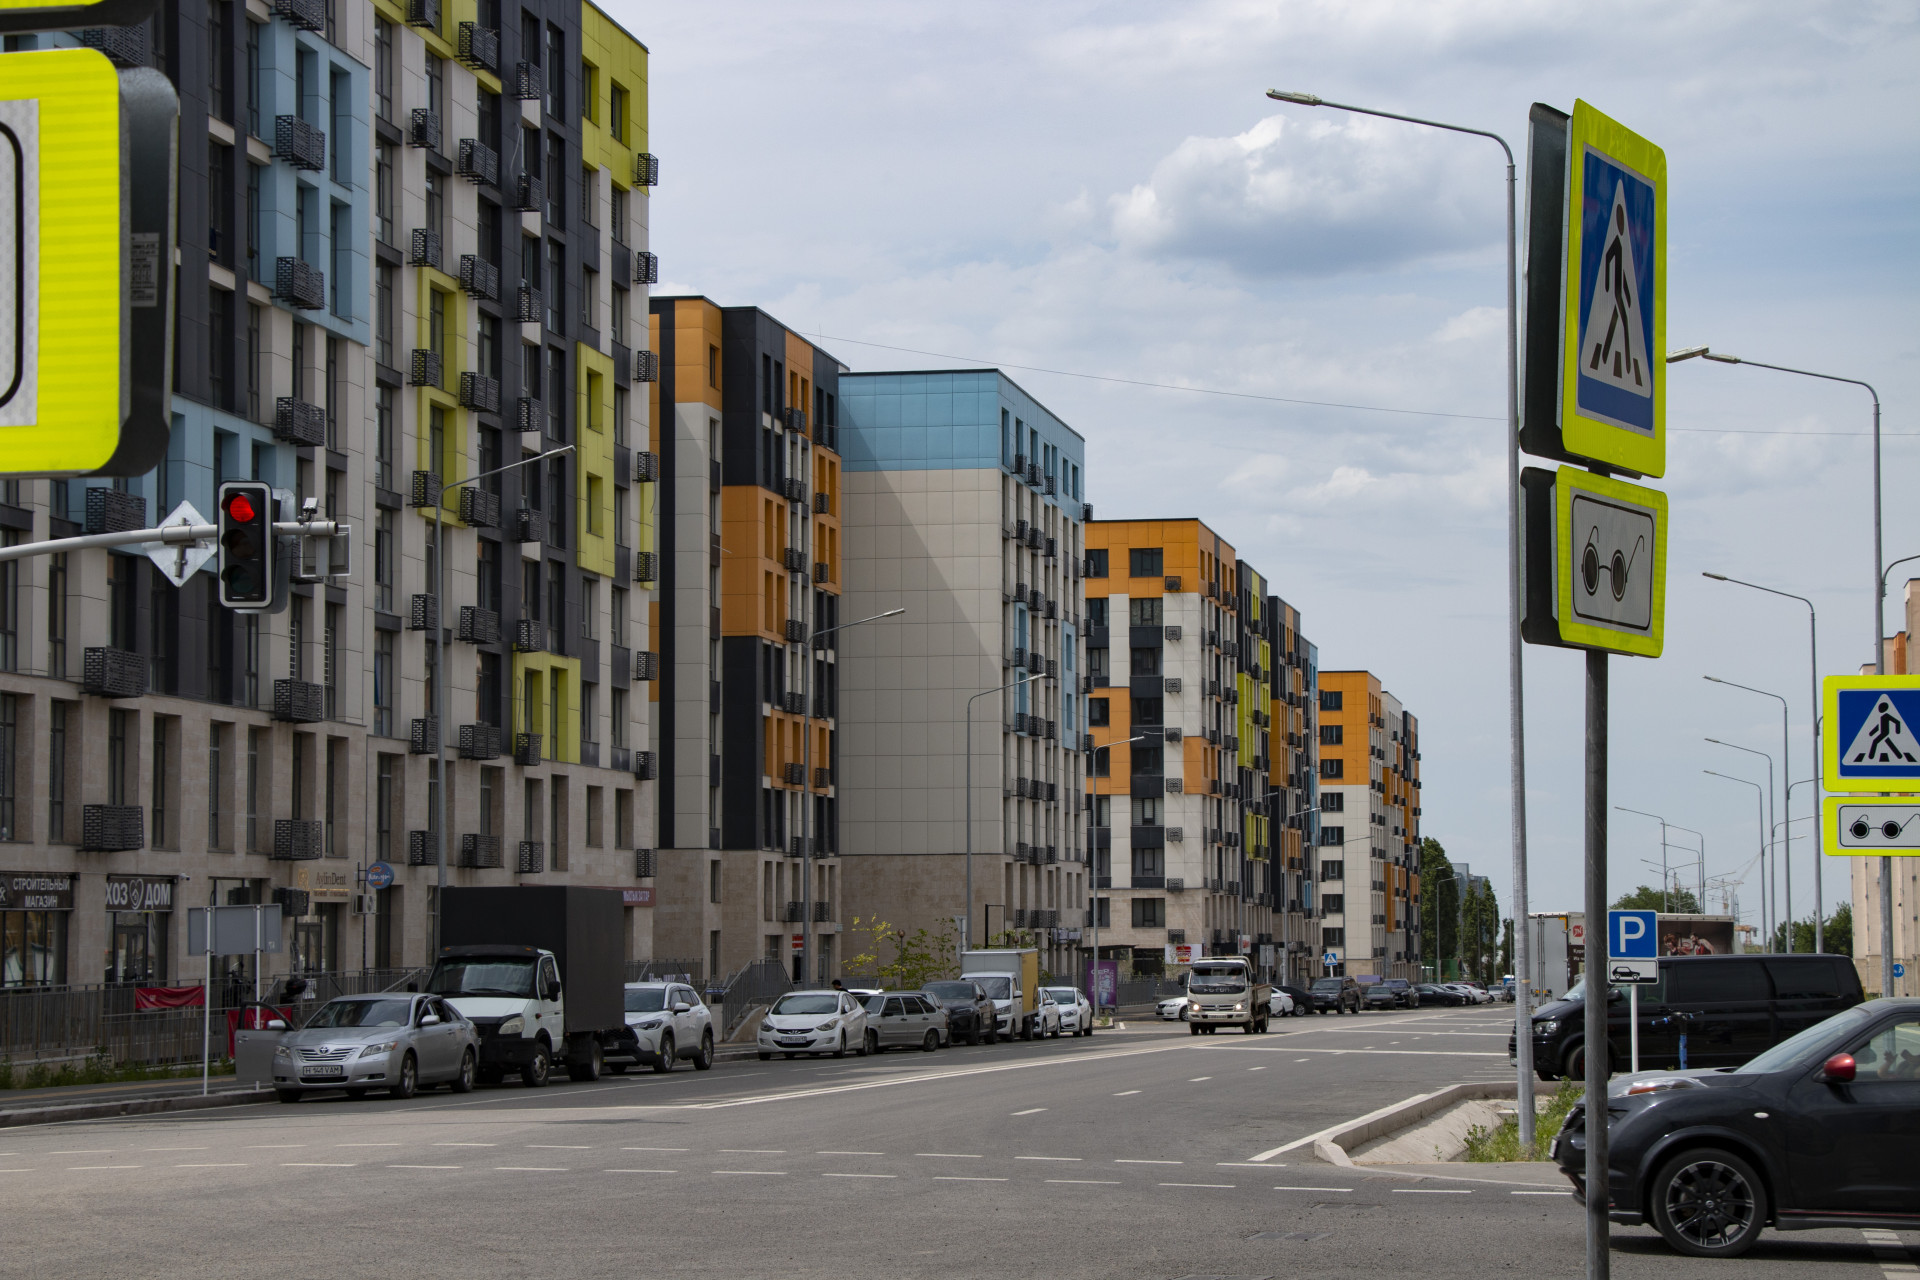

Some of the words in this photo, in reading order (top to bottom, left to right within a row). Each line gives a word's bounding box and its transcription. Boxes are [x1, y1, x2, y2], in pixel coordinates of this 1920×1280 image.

[12, 877, 71, 891] СТРОИТЕЛЬНЫЙ
[24, 895, 58, 908] МАГАЗИН
[105, 882, 128, 906] ХОЗ
[144, 883, 171, 910] ДОМ
[1619, 916, 1646, 953] P
[325, 1066, 340, 1074] VAM
